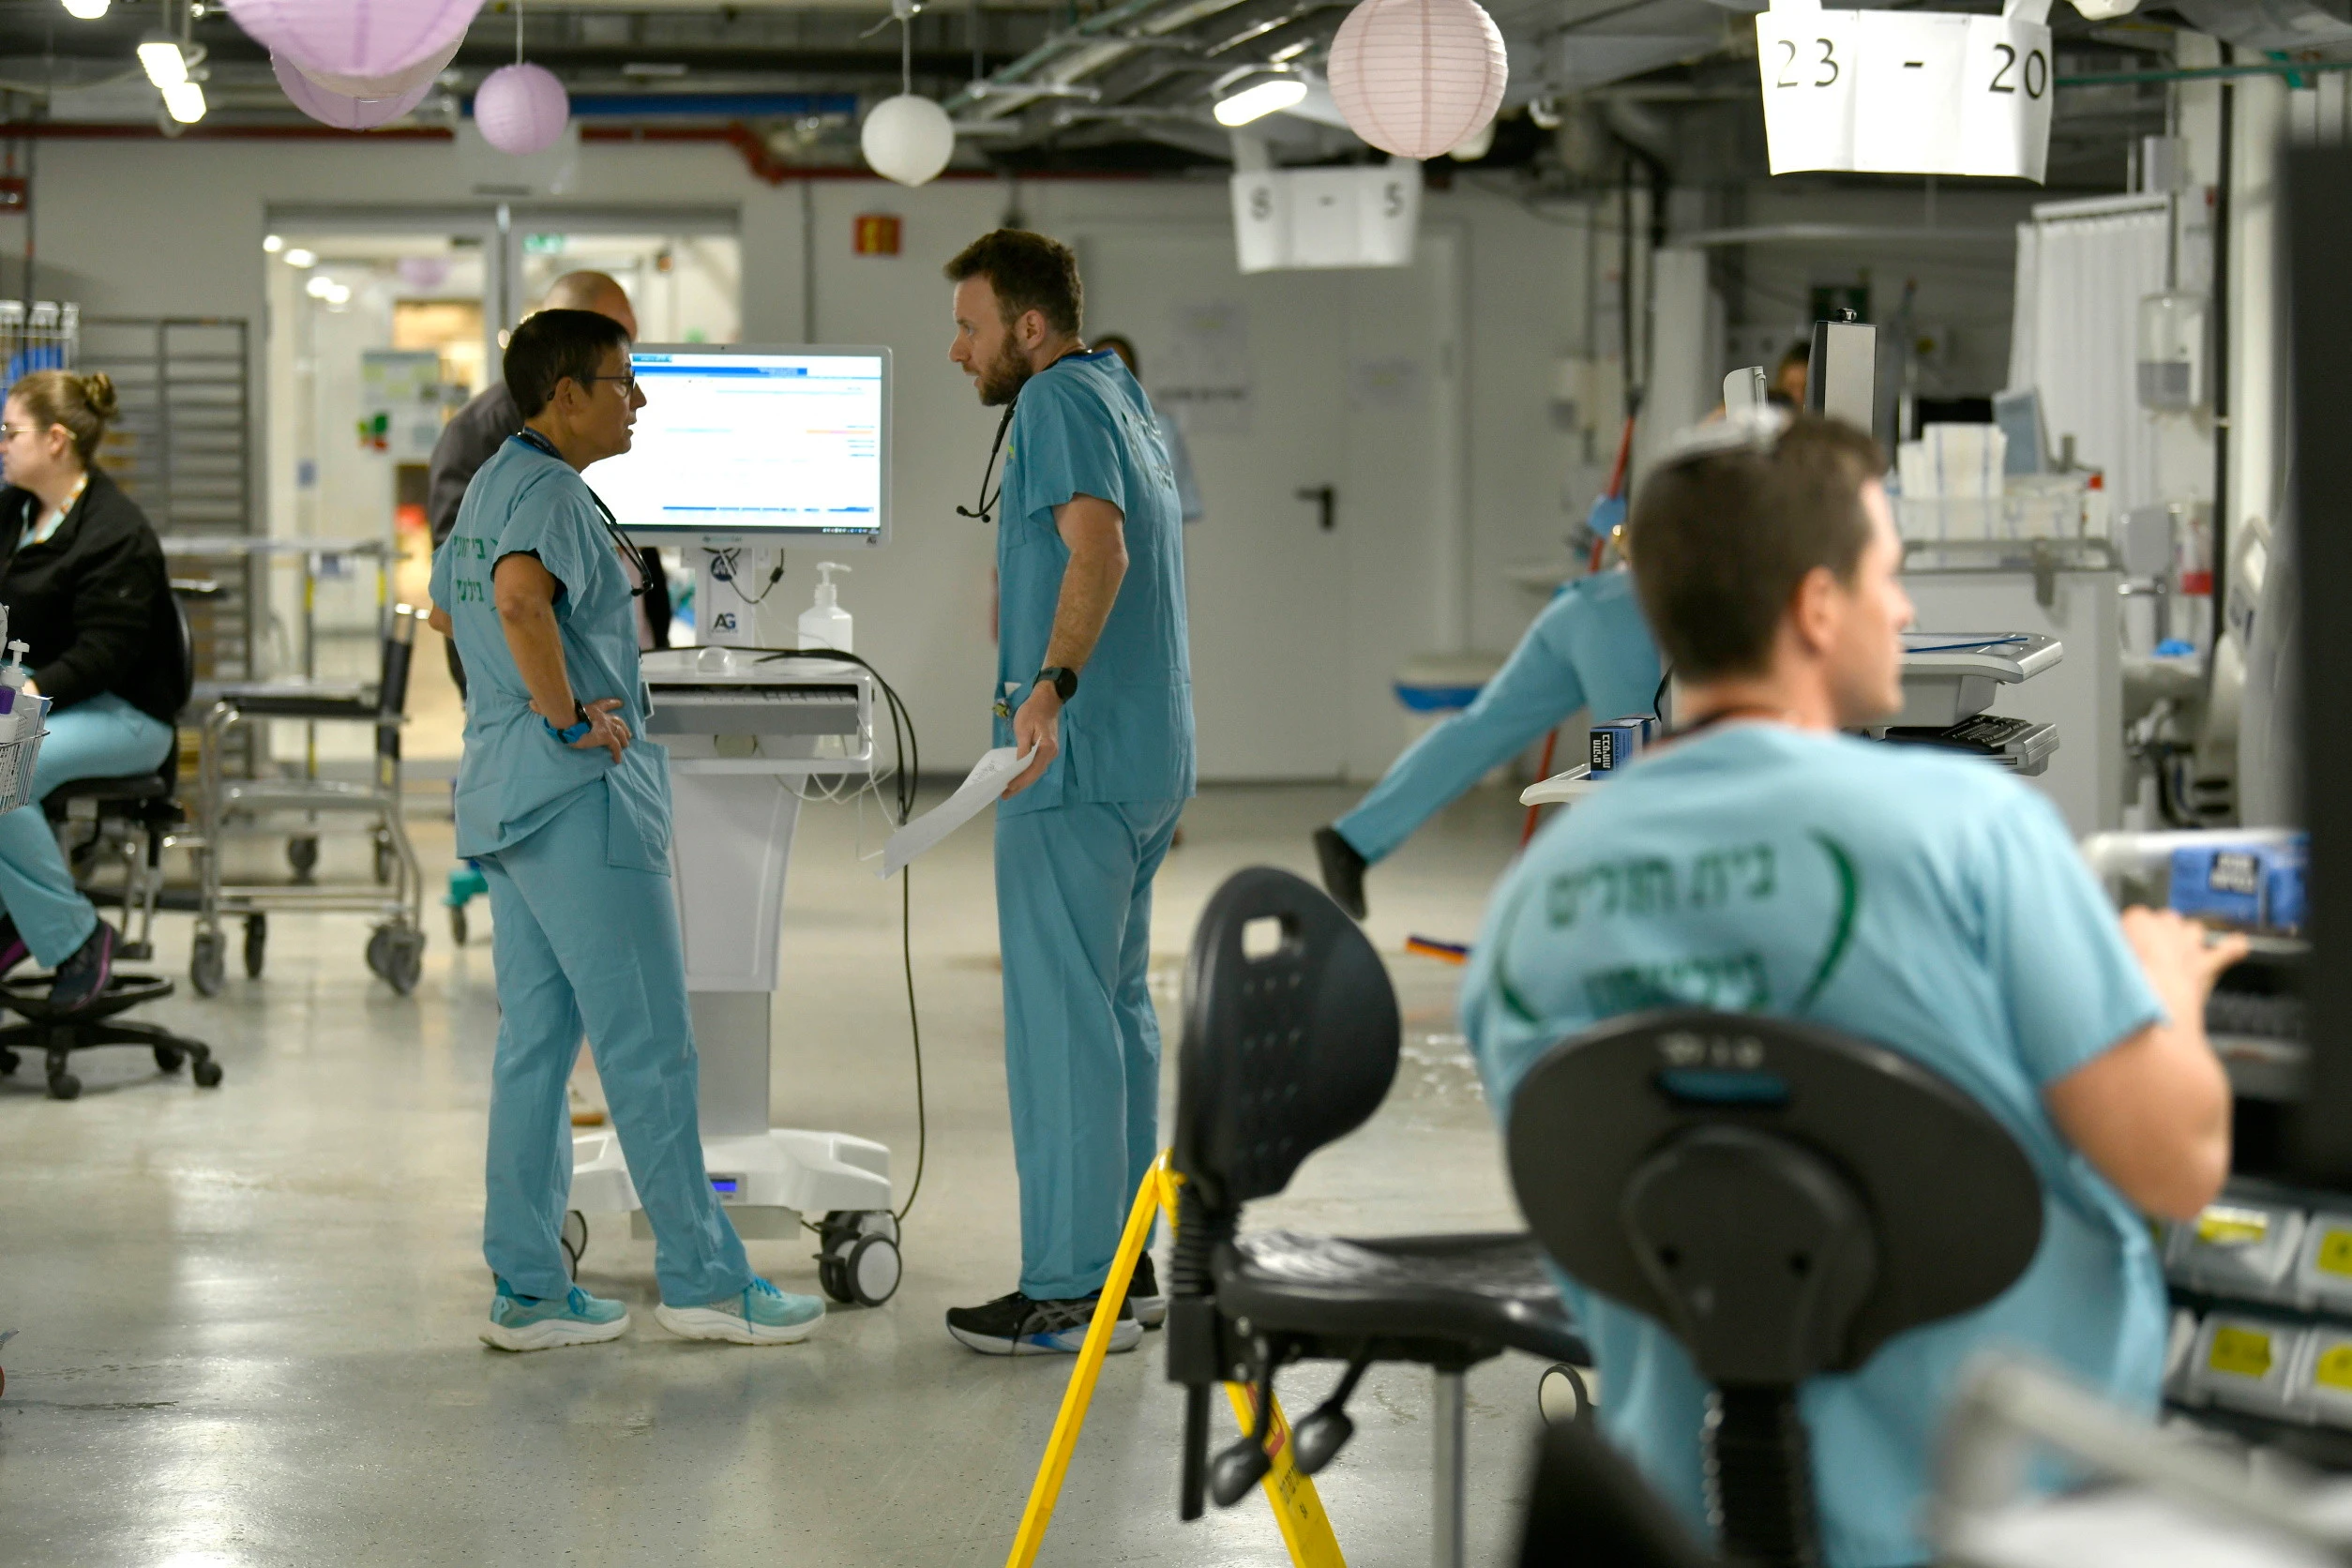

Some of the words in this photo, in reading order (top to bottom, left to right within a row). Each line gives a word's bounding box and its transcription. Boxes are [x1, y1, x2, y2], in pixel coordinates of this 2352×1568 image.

[1776, 38, 1839, 89] 23
[1987, 43, 2047, 100] 20
[1382, 181, 1405, 219] 5
[713, 612, 737, 630] AG
[1592, 739, 1602, 763] חזקים
[1602, 733, 1610, 769] בבטיחות
